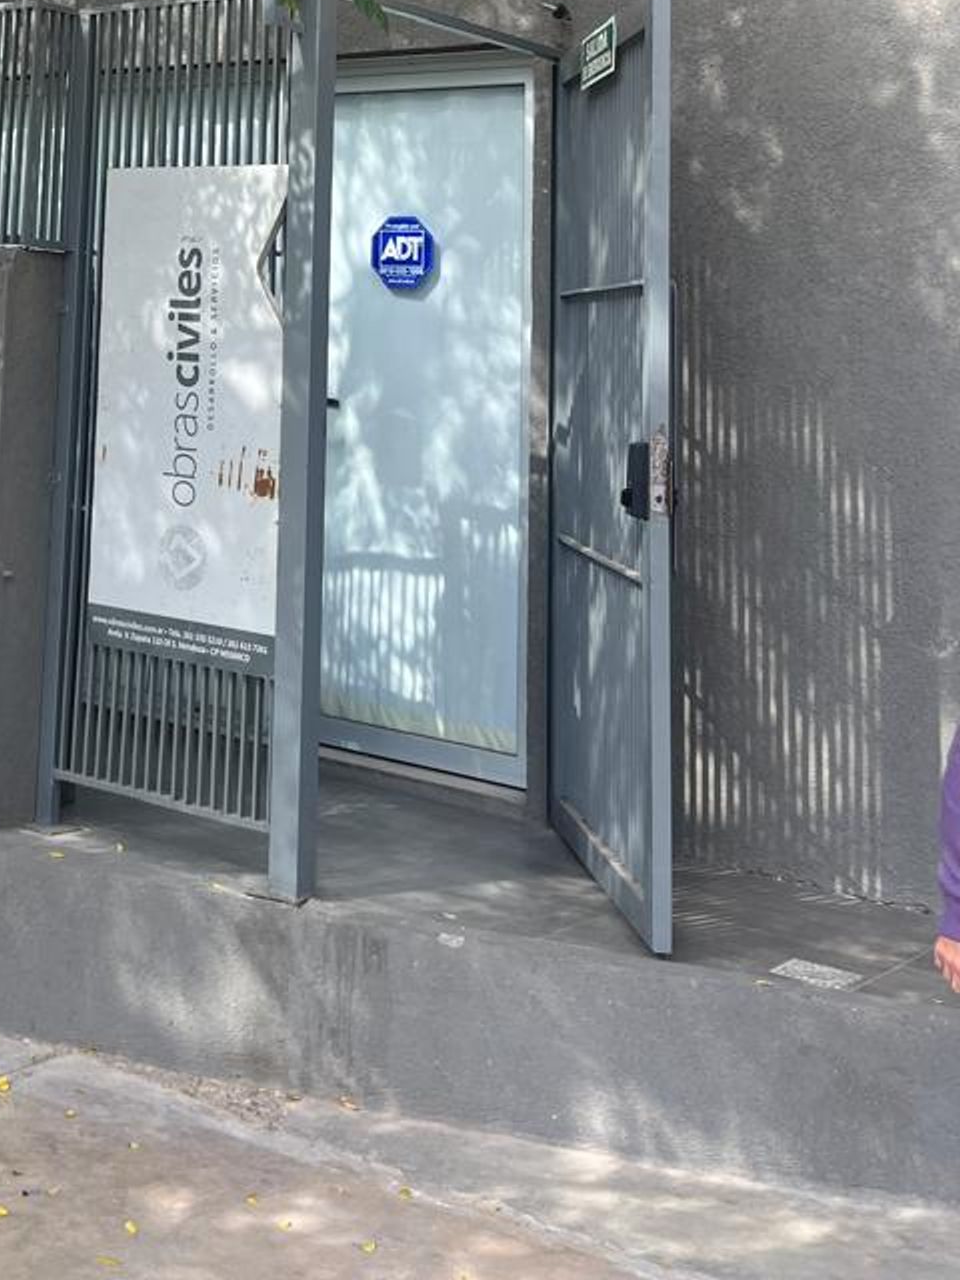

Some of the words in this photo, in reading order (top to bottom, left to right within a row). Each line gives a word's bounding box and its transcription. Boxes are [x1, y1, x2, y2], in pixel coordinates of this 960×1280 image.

[209, 248, 220, 321] SERVICIOS
[380, 235, 425, 262] ADT
[206, 341, 218, 432] DESARROLLO
